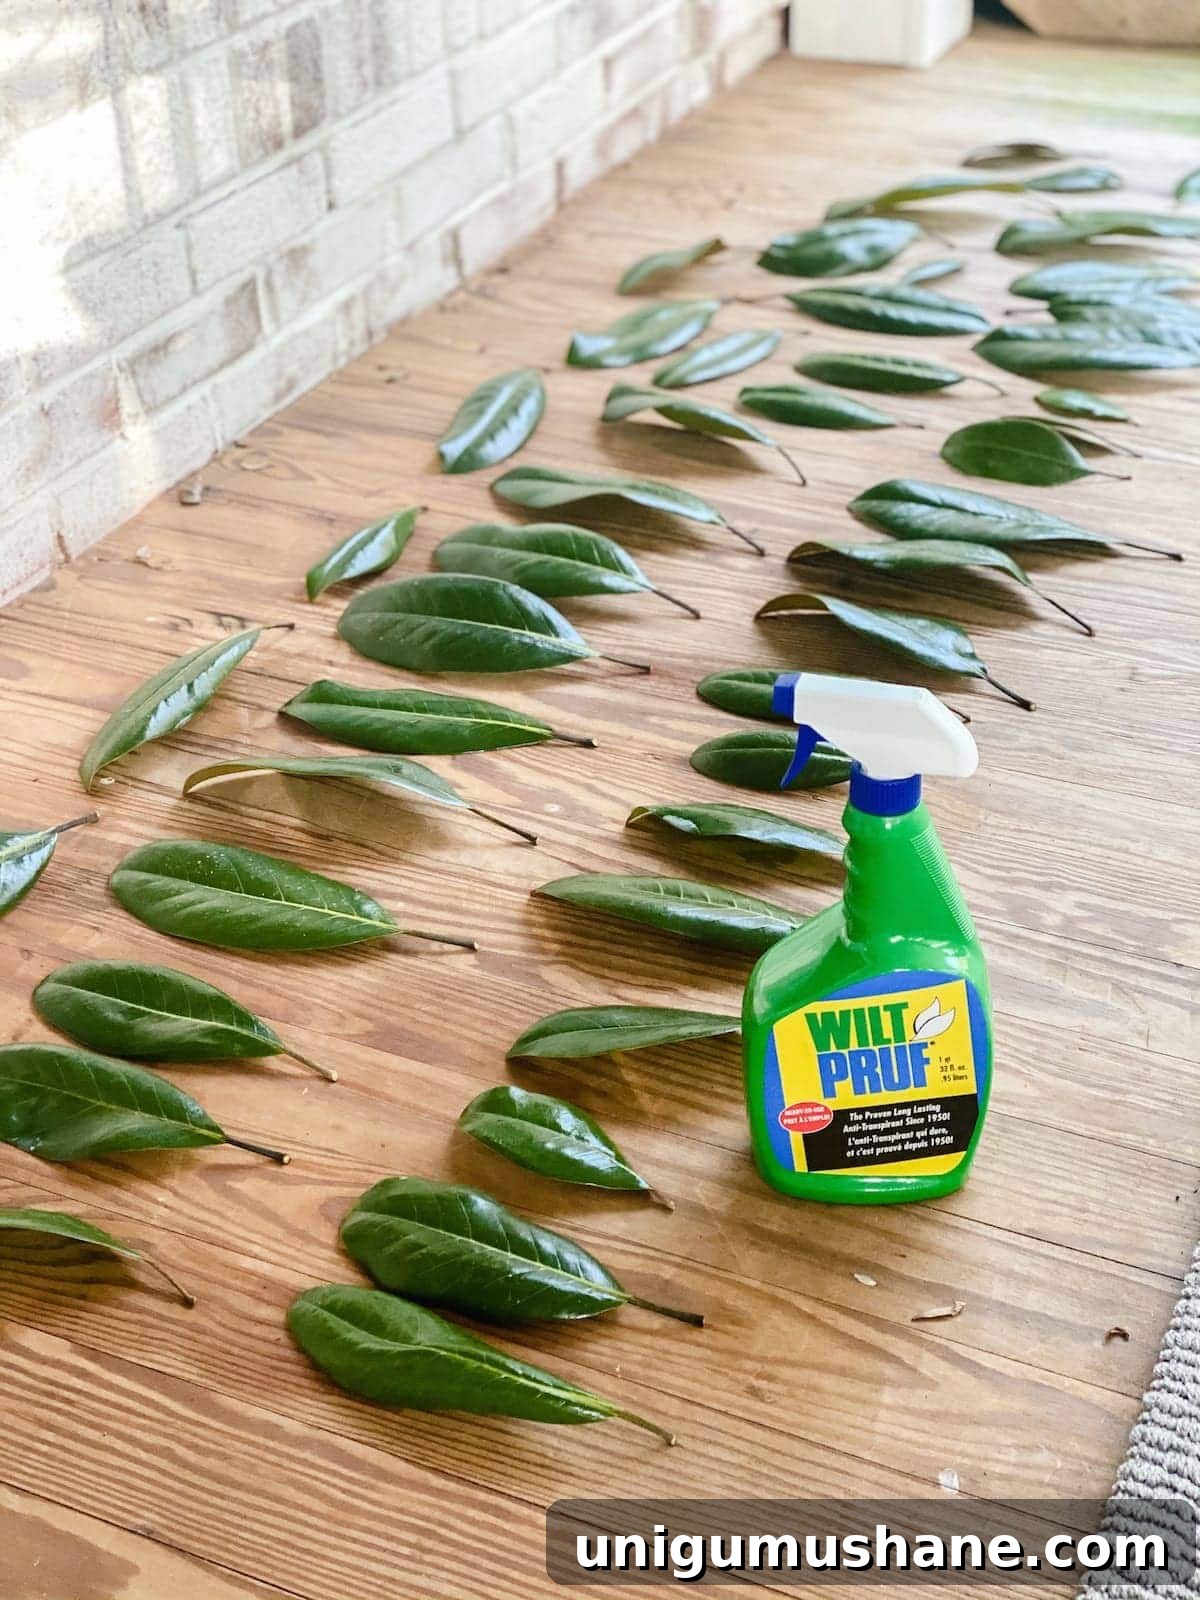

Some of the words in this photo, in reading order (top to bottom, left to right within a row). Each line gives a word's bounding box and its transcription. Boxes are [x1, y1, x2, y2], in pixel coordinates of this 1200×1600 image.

[805, 1002, 909, 1051] WILT
[817, 1042, 930, 1099] PRUF
[843, 1119, 903, 1132] Anti-Transpirant
[904, 1116, 925, 1126] Since
[927, 1111, 951, 1123] 1950!
[849, 1112, 864, 1121] The
[864, 1110, 893, 1120] Proven
[893, 1107, 912, 1117] Long
[913, 1103, 941, 1114] Lasting
[846, 1150, 855, 1158] et
[855, 1147, 874, 1156] c'est
[903, 1140, 929, 1152] depuis
[930, 1135, 954, 1147] 1950!
[848, 1131, 914, 1146] L'anti-Transpirant
[915, 1127, 928, 1140] qui
[928, 1126, 949, 1136] dure,
